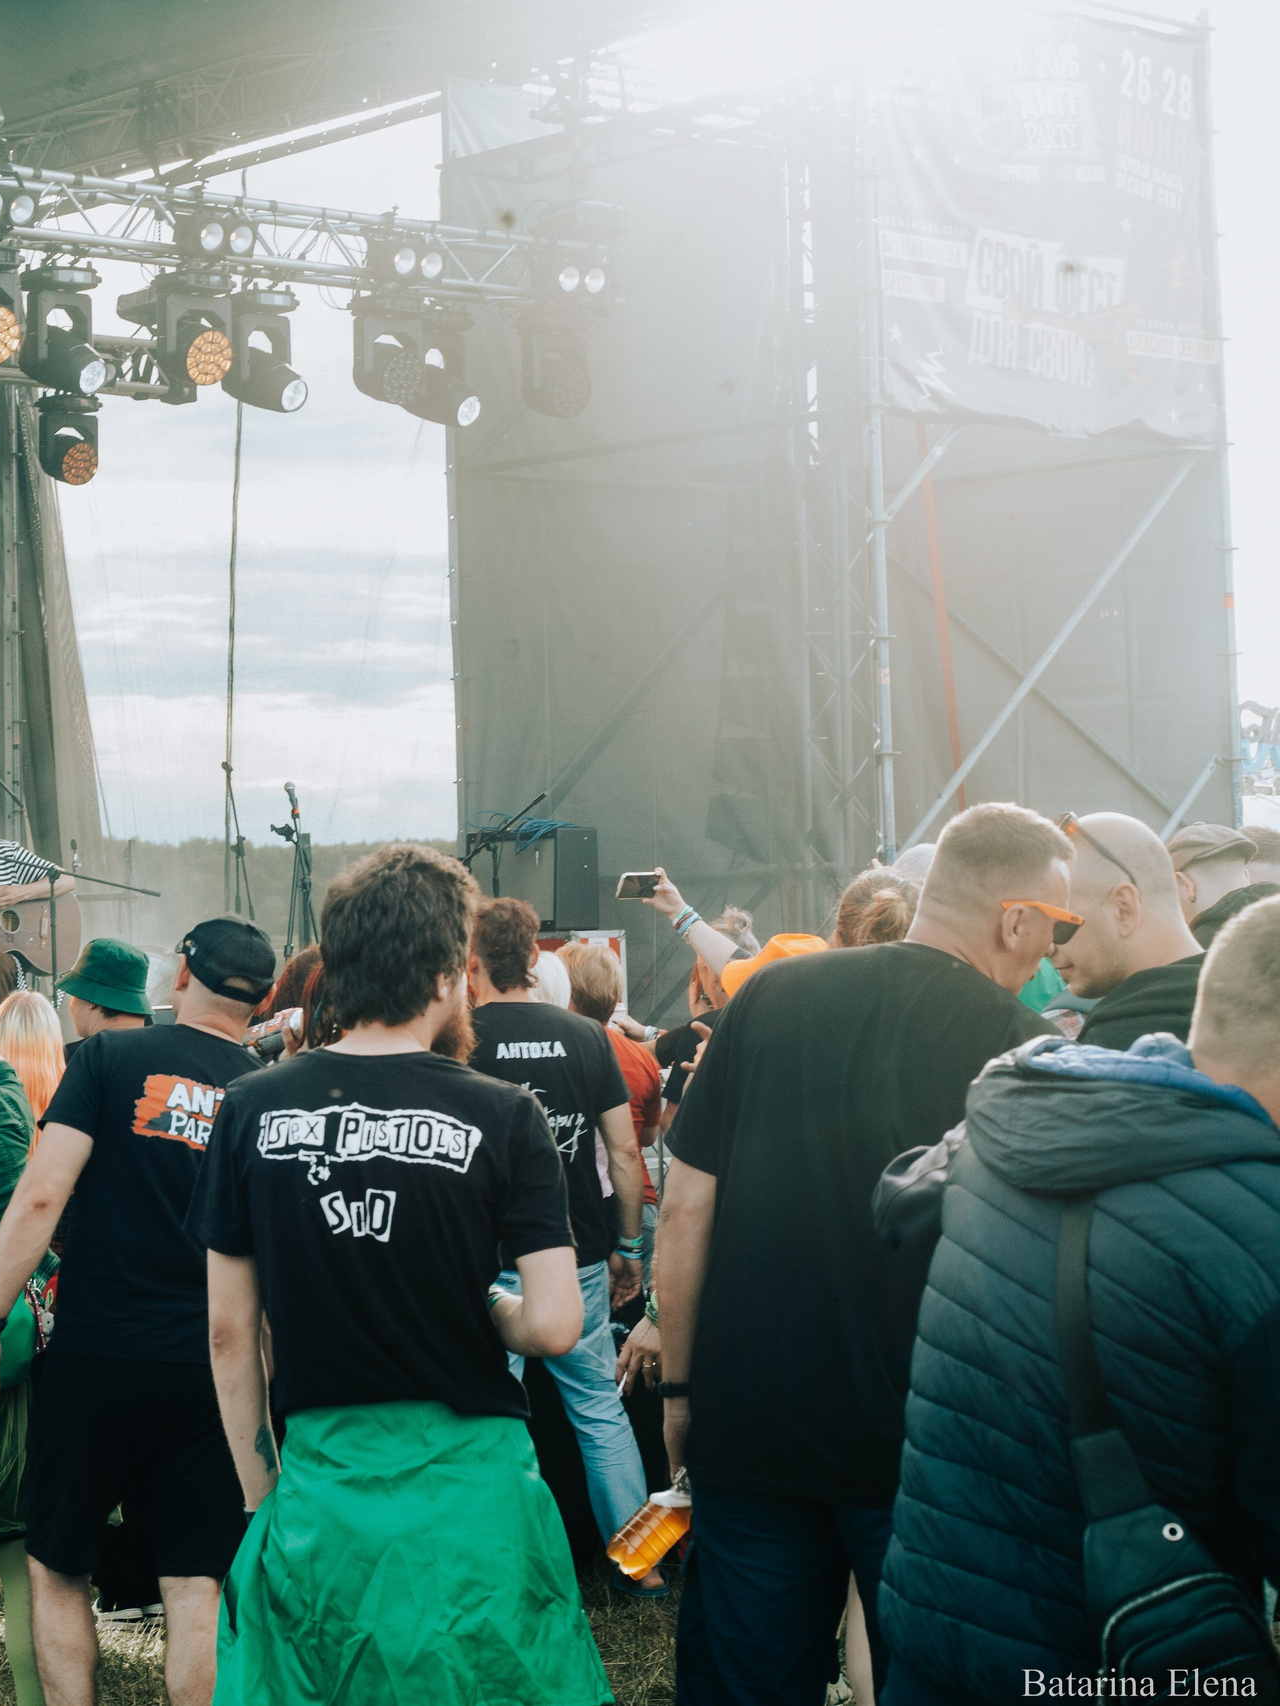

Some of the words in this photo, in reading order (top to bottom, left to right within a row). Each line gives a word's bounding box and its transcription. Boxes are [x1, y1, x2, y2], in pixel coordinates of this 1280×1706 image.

[1120, 48, 1193, 122] 26-28
[1023, 122, 1078, 151] PARTY
[976, 236, 1044, 311] СВОЙ
[967, 310, 1018, 370] ДЛЯ
[496, 1041, 568, 1059] АНТОХА
[168, 1109, 213, 1145] PAR
